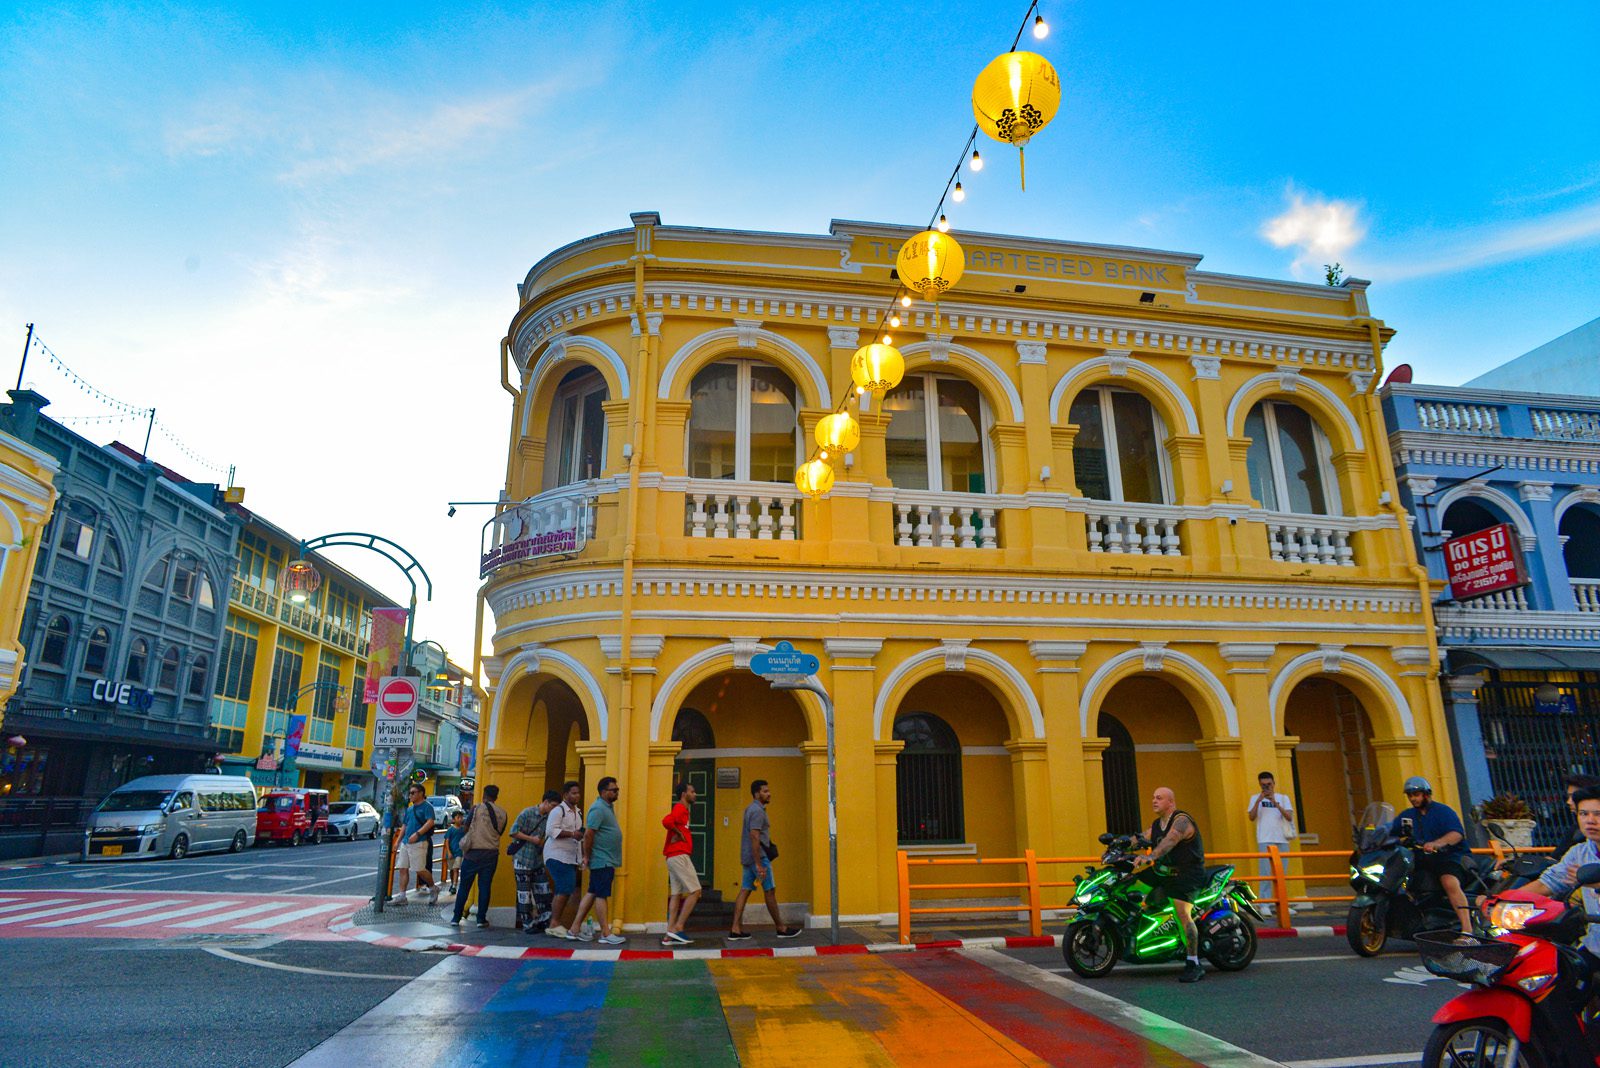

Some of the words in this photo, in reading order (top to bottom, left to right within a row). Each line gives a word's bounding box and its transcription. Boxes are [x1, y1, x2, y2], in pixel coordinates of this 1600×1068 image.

[963, 248, 1094, 277] ARTERED
[1104, 262, 1170, 285] BANK
[532, 541, 576, 556] MUSEUM
[1454, 560, 1470, 572] DO
[1472, 555, 1489, 566] RE
[1492, 550, 1506, 560] MI
[1473, 574, 1507, 588] 215174
[378, 722, 412, 734] ห้ามเข้า
